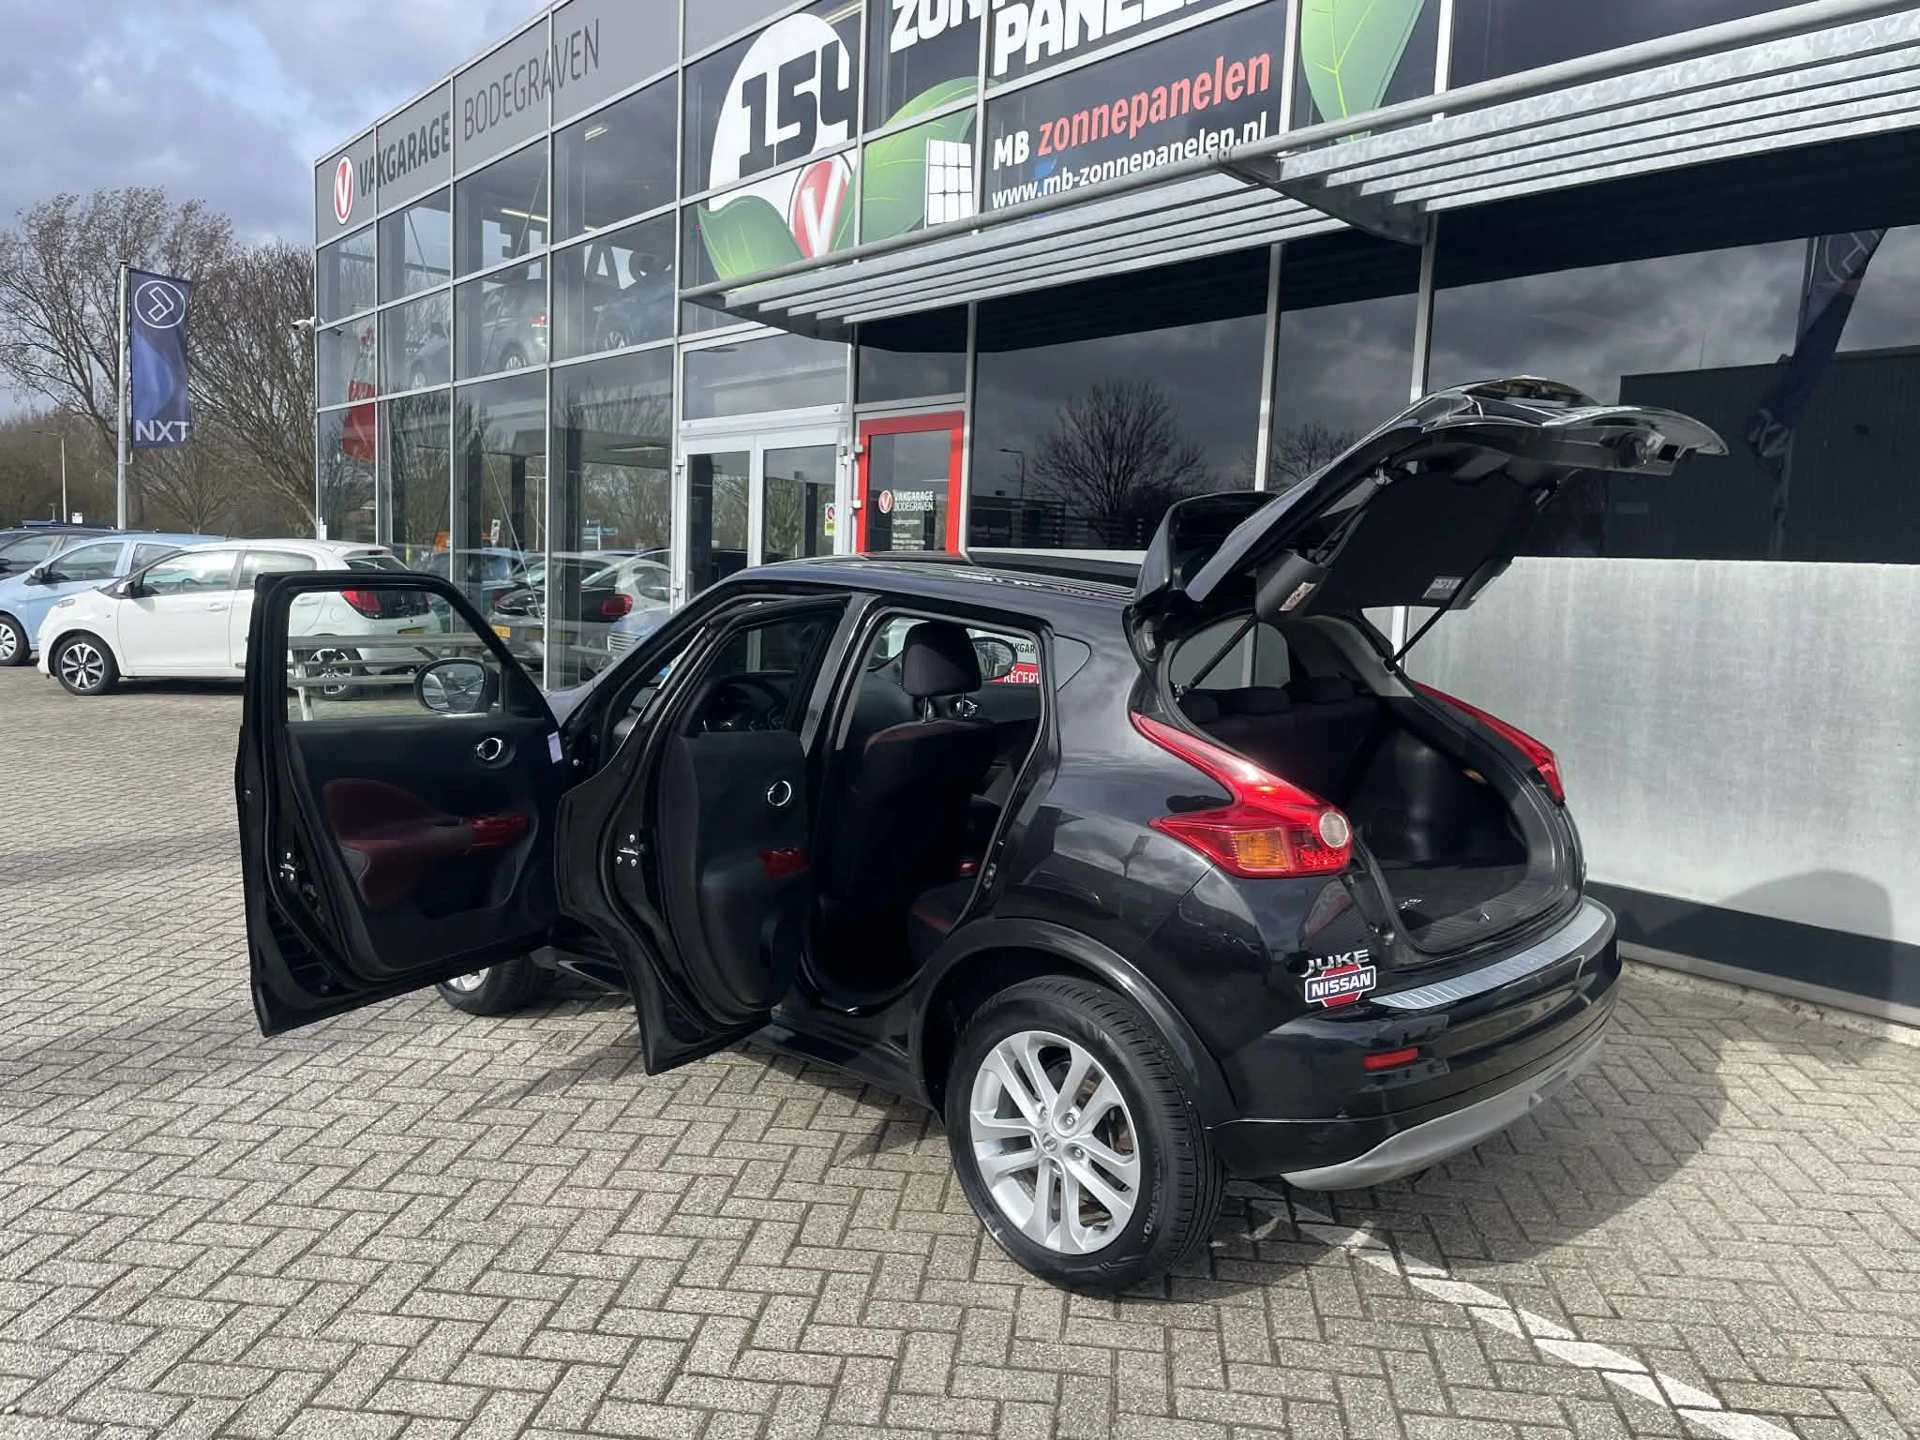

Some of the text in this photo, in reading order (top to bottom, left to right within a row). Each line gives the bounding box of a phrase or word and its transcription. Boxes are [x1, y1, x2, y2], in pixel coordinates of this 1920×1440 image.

[359, 110, 450, 198] VAKGARAGE
[463, 18, 600, 143] BODEGRAVEN
[993, 51, 1271, 170] MB zonnepanelen
[991, 111, 1267, 209] www.mb-zonnepanelen.nl
[135, 419, 190, 442] NXT
[1300, 949, 1370, 978] JUKE
[1311, 972, 1371, 998] NISSAN
